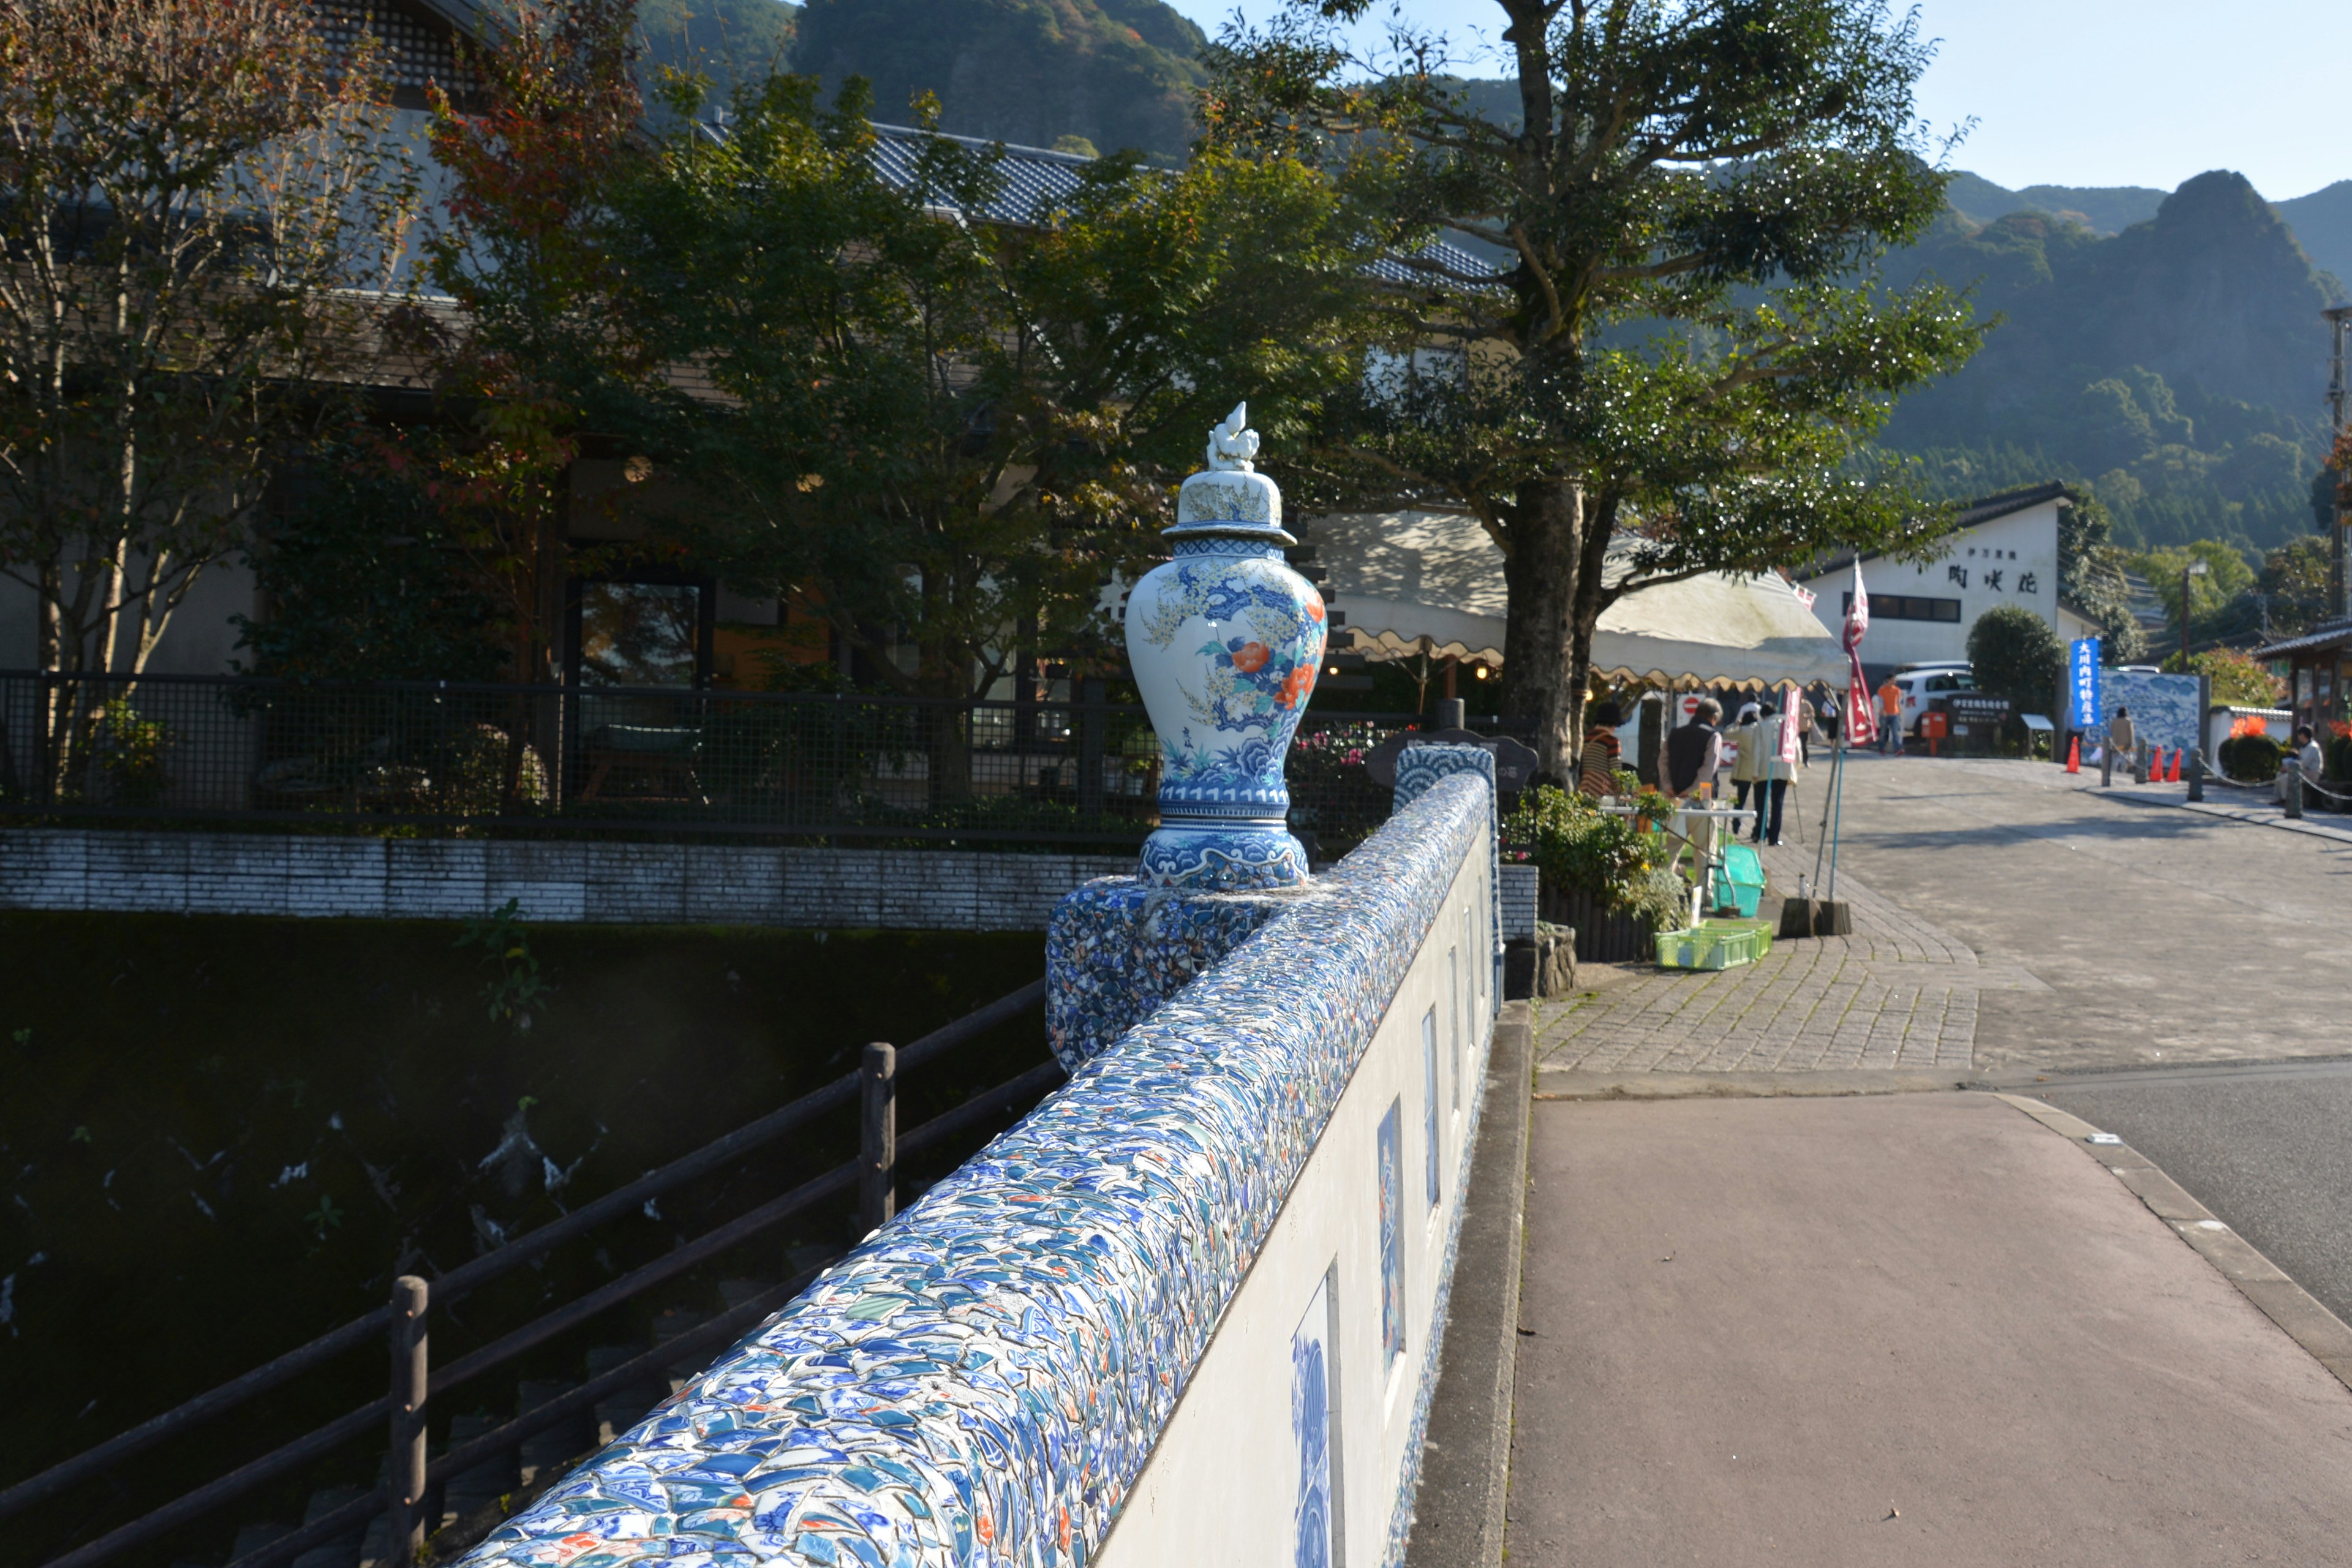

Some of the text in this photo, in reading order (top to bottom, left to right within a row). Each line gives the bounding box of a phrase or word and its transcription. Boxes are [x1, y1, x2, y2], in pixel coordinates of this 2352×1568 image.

[2078, 641, 2094, 725] 大川内町特産品
